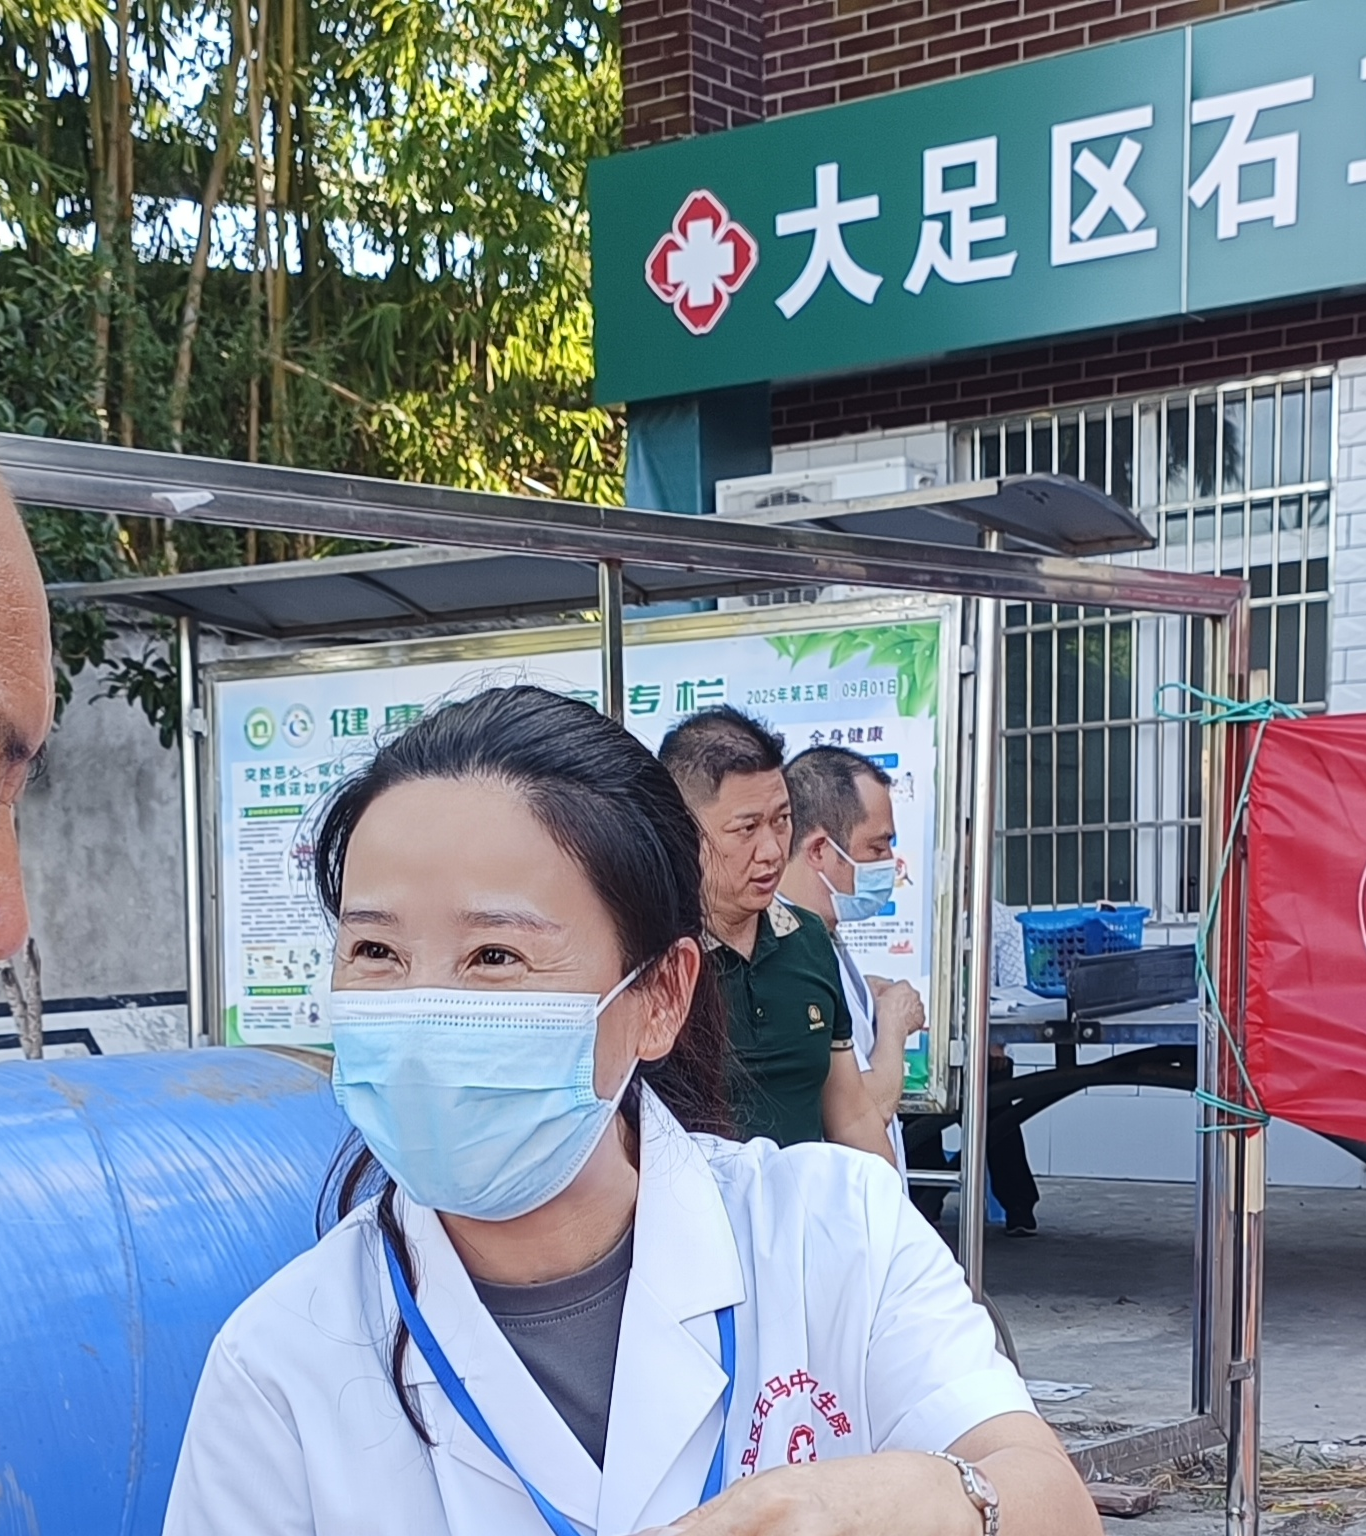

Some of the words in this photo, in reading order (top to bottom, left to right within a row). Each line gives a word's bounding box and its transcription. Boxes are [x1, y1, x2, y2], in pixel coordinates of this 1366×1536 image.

[746, 683, 829, 705] 2025年第五期
[842, 678, 898, 699] 09月01日
[808, 725, 885, 746] 全身健康
